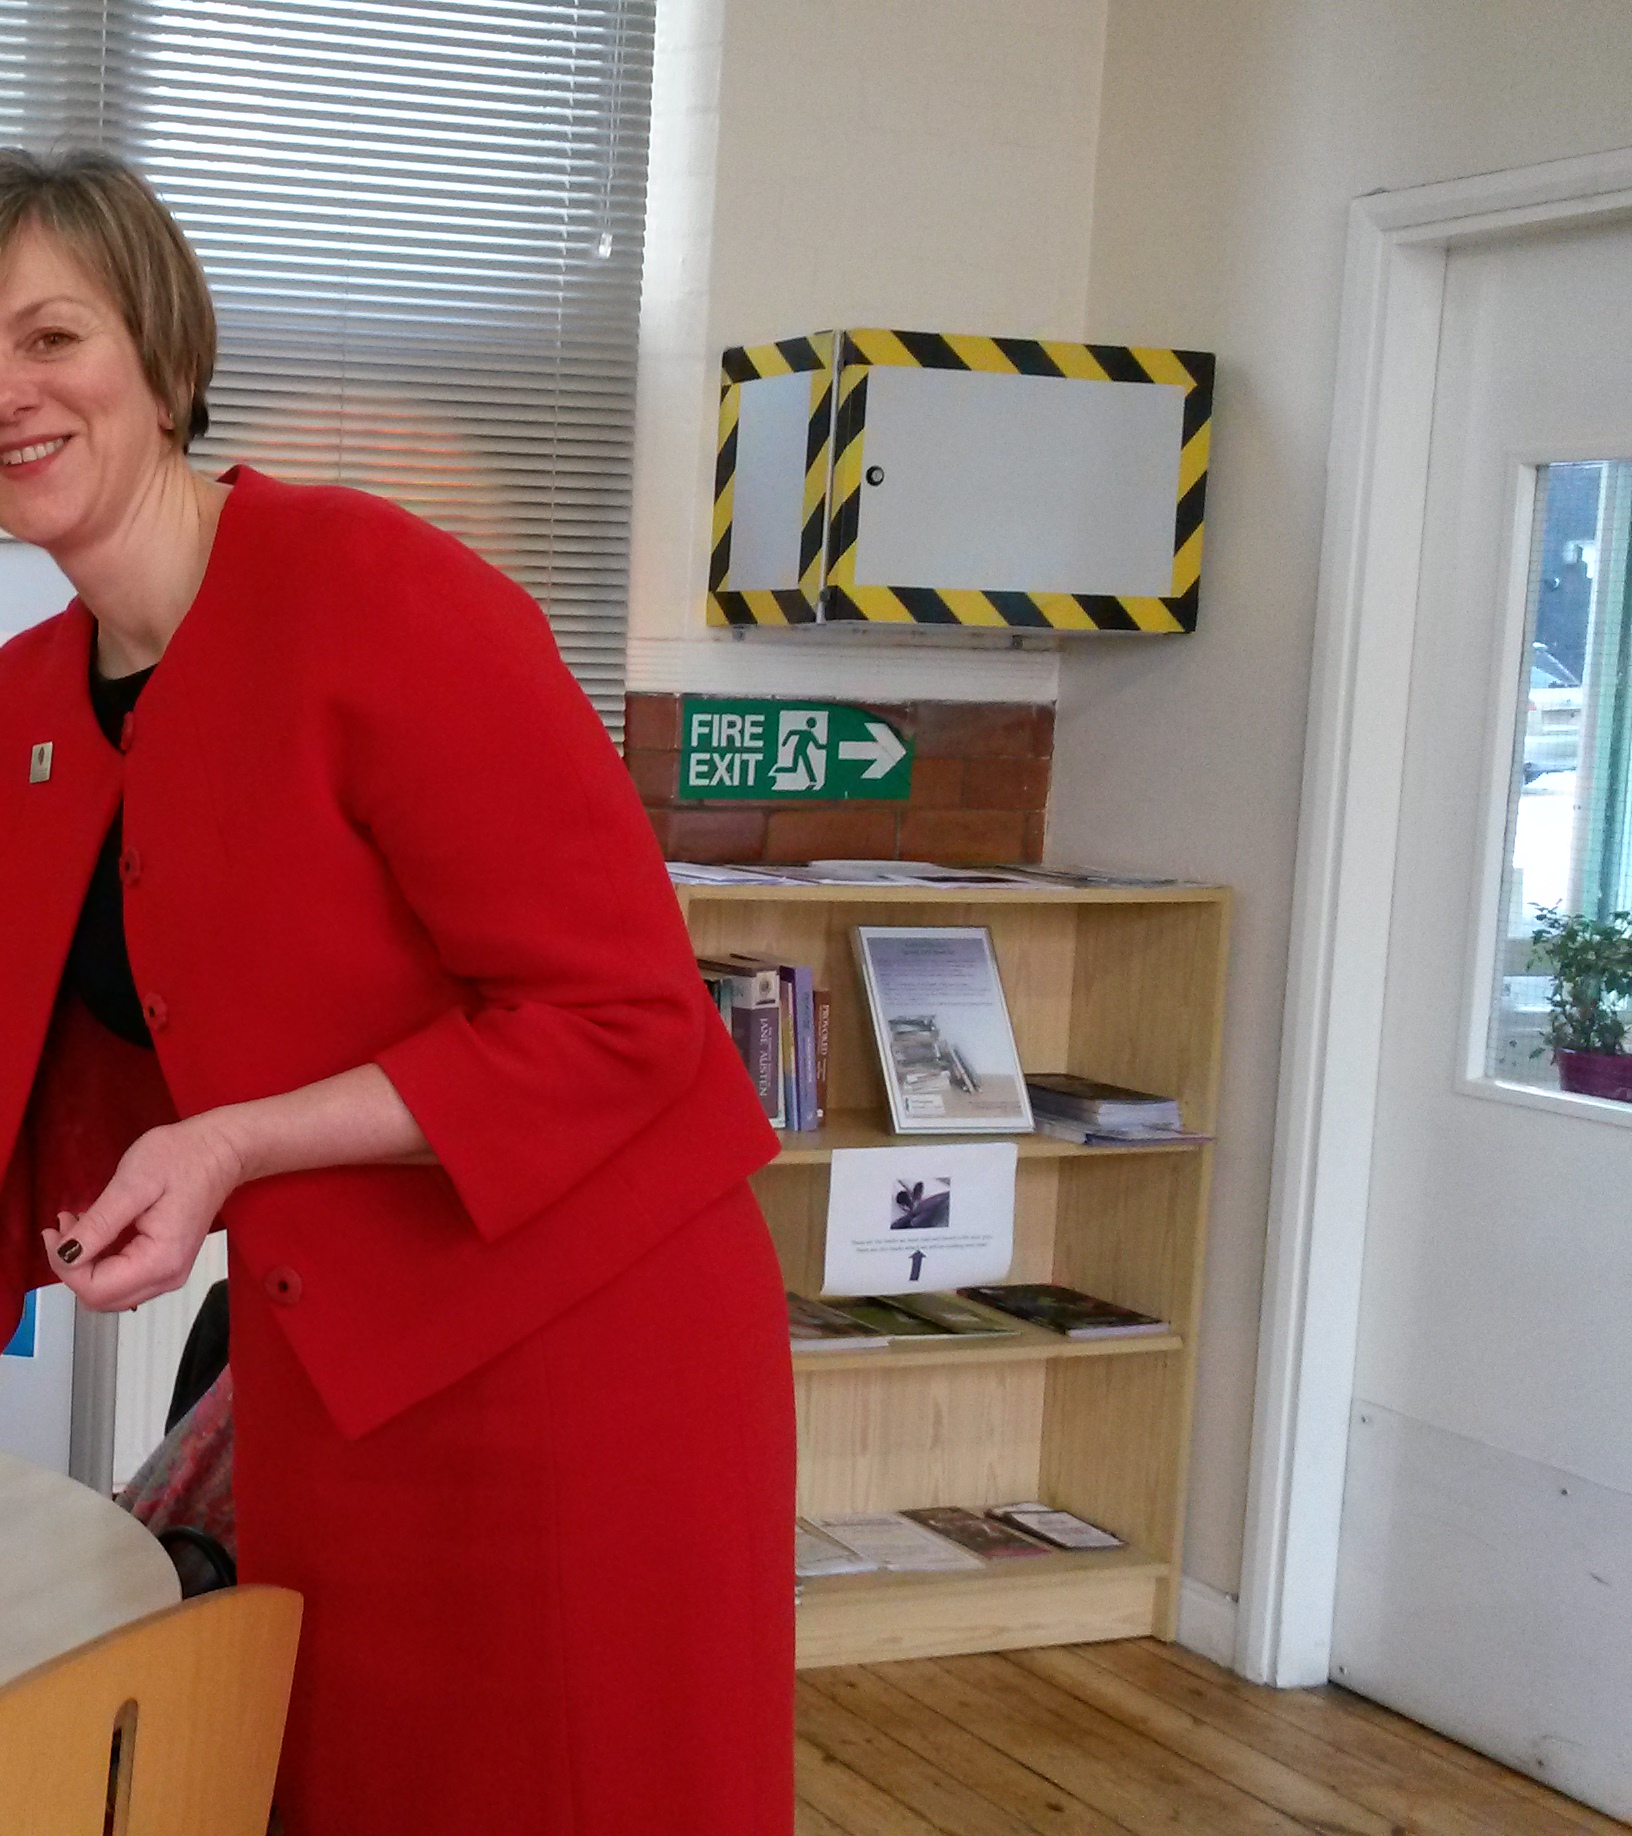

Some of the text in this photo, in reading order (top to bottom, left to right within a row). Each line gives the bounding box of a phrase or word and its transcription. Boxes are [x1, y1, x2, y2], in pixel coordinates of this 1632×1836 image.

[690, 713, 766, 749] FIRE
[688, 752, 765, 787] EXIT
[758, 1017, 769, 1097] JANE AUSTEN
